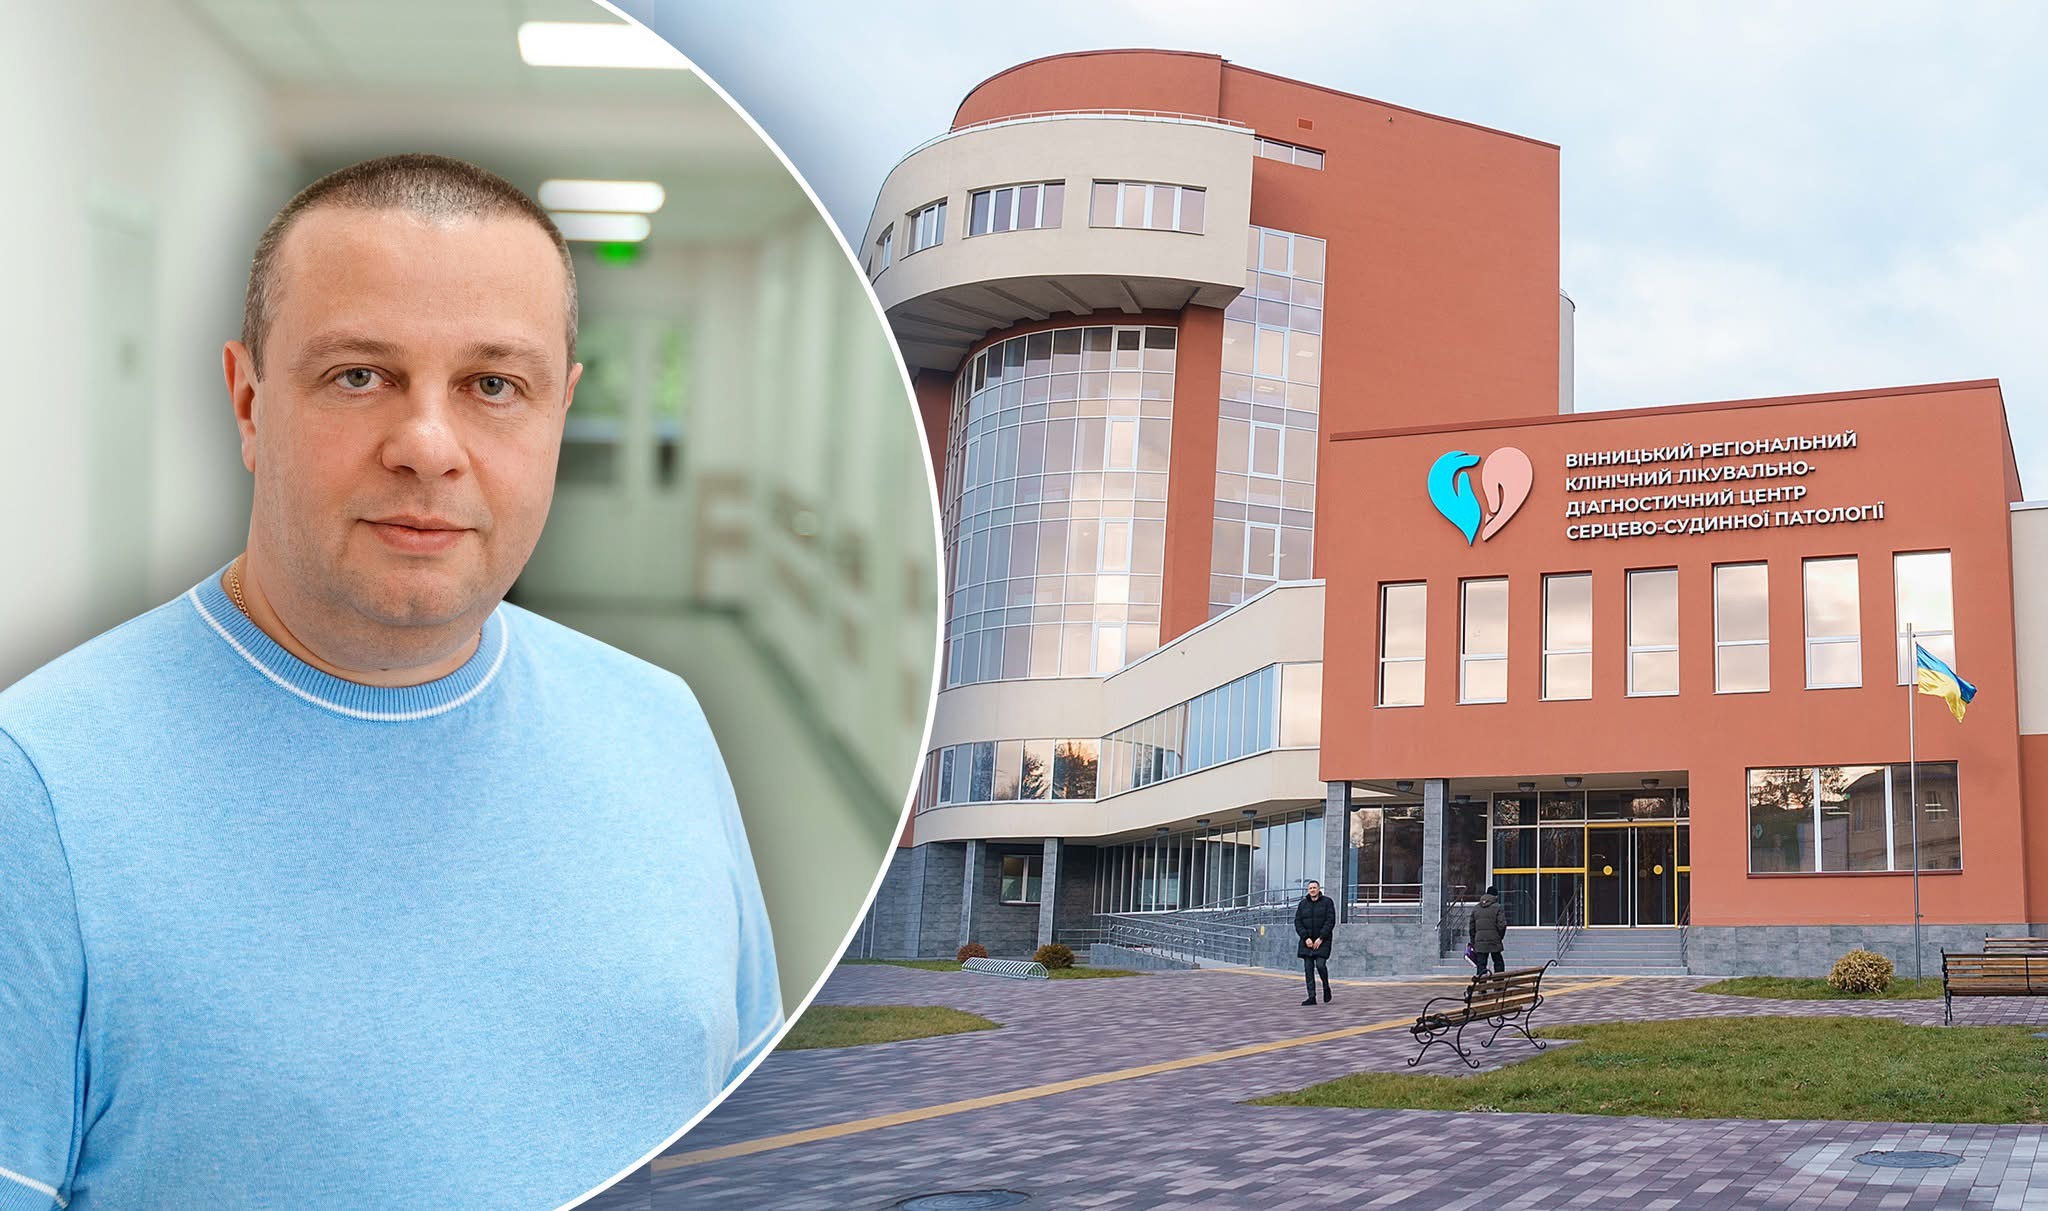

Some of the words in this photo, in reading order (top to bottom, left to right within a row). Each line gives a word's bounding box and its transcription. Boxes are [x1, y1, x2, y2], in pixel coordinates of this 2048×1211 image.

[1565, 442, 1694, 468] ВІННИЦЬКИЙ
[1700, 430, 1858, 458] РЕГІОНАЛЬНИЙ
[1565, 468, 1672, 492] КЛІНІЧНИЙ
[1677, 460, 1816, 484] ЛІКУВАЛЬНО-
[1565, 488, 1734, 518] ДІАГНОСТИЧНИЙ
[1740, 485, 1807, 506] ЦЕНТР
[1566, 511, 1770, 541] СЕРЦЕВО-СУДИННОЇ
[1775, 501, 1885, 527] ПАТОЛОГІЇ
